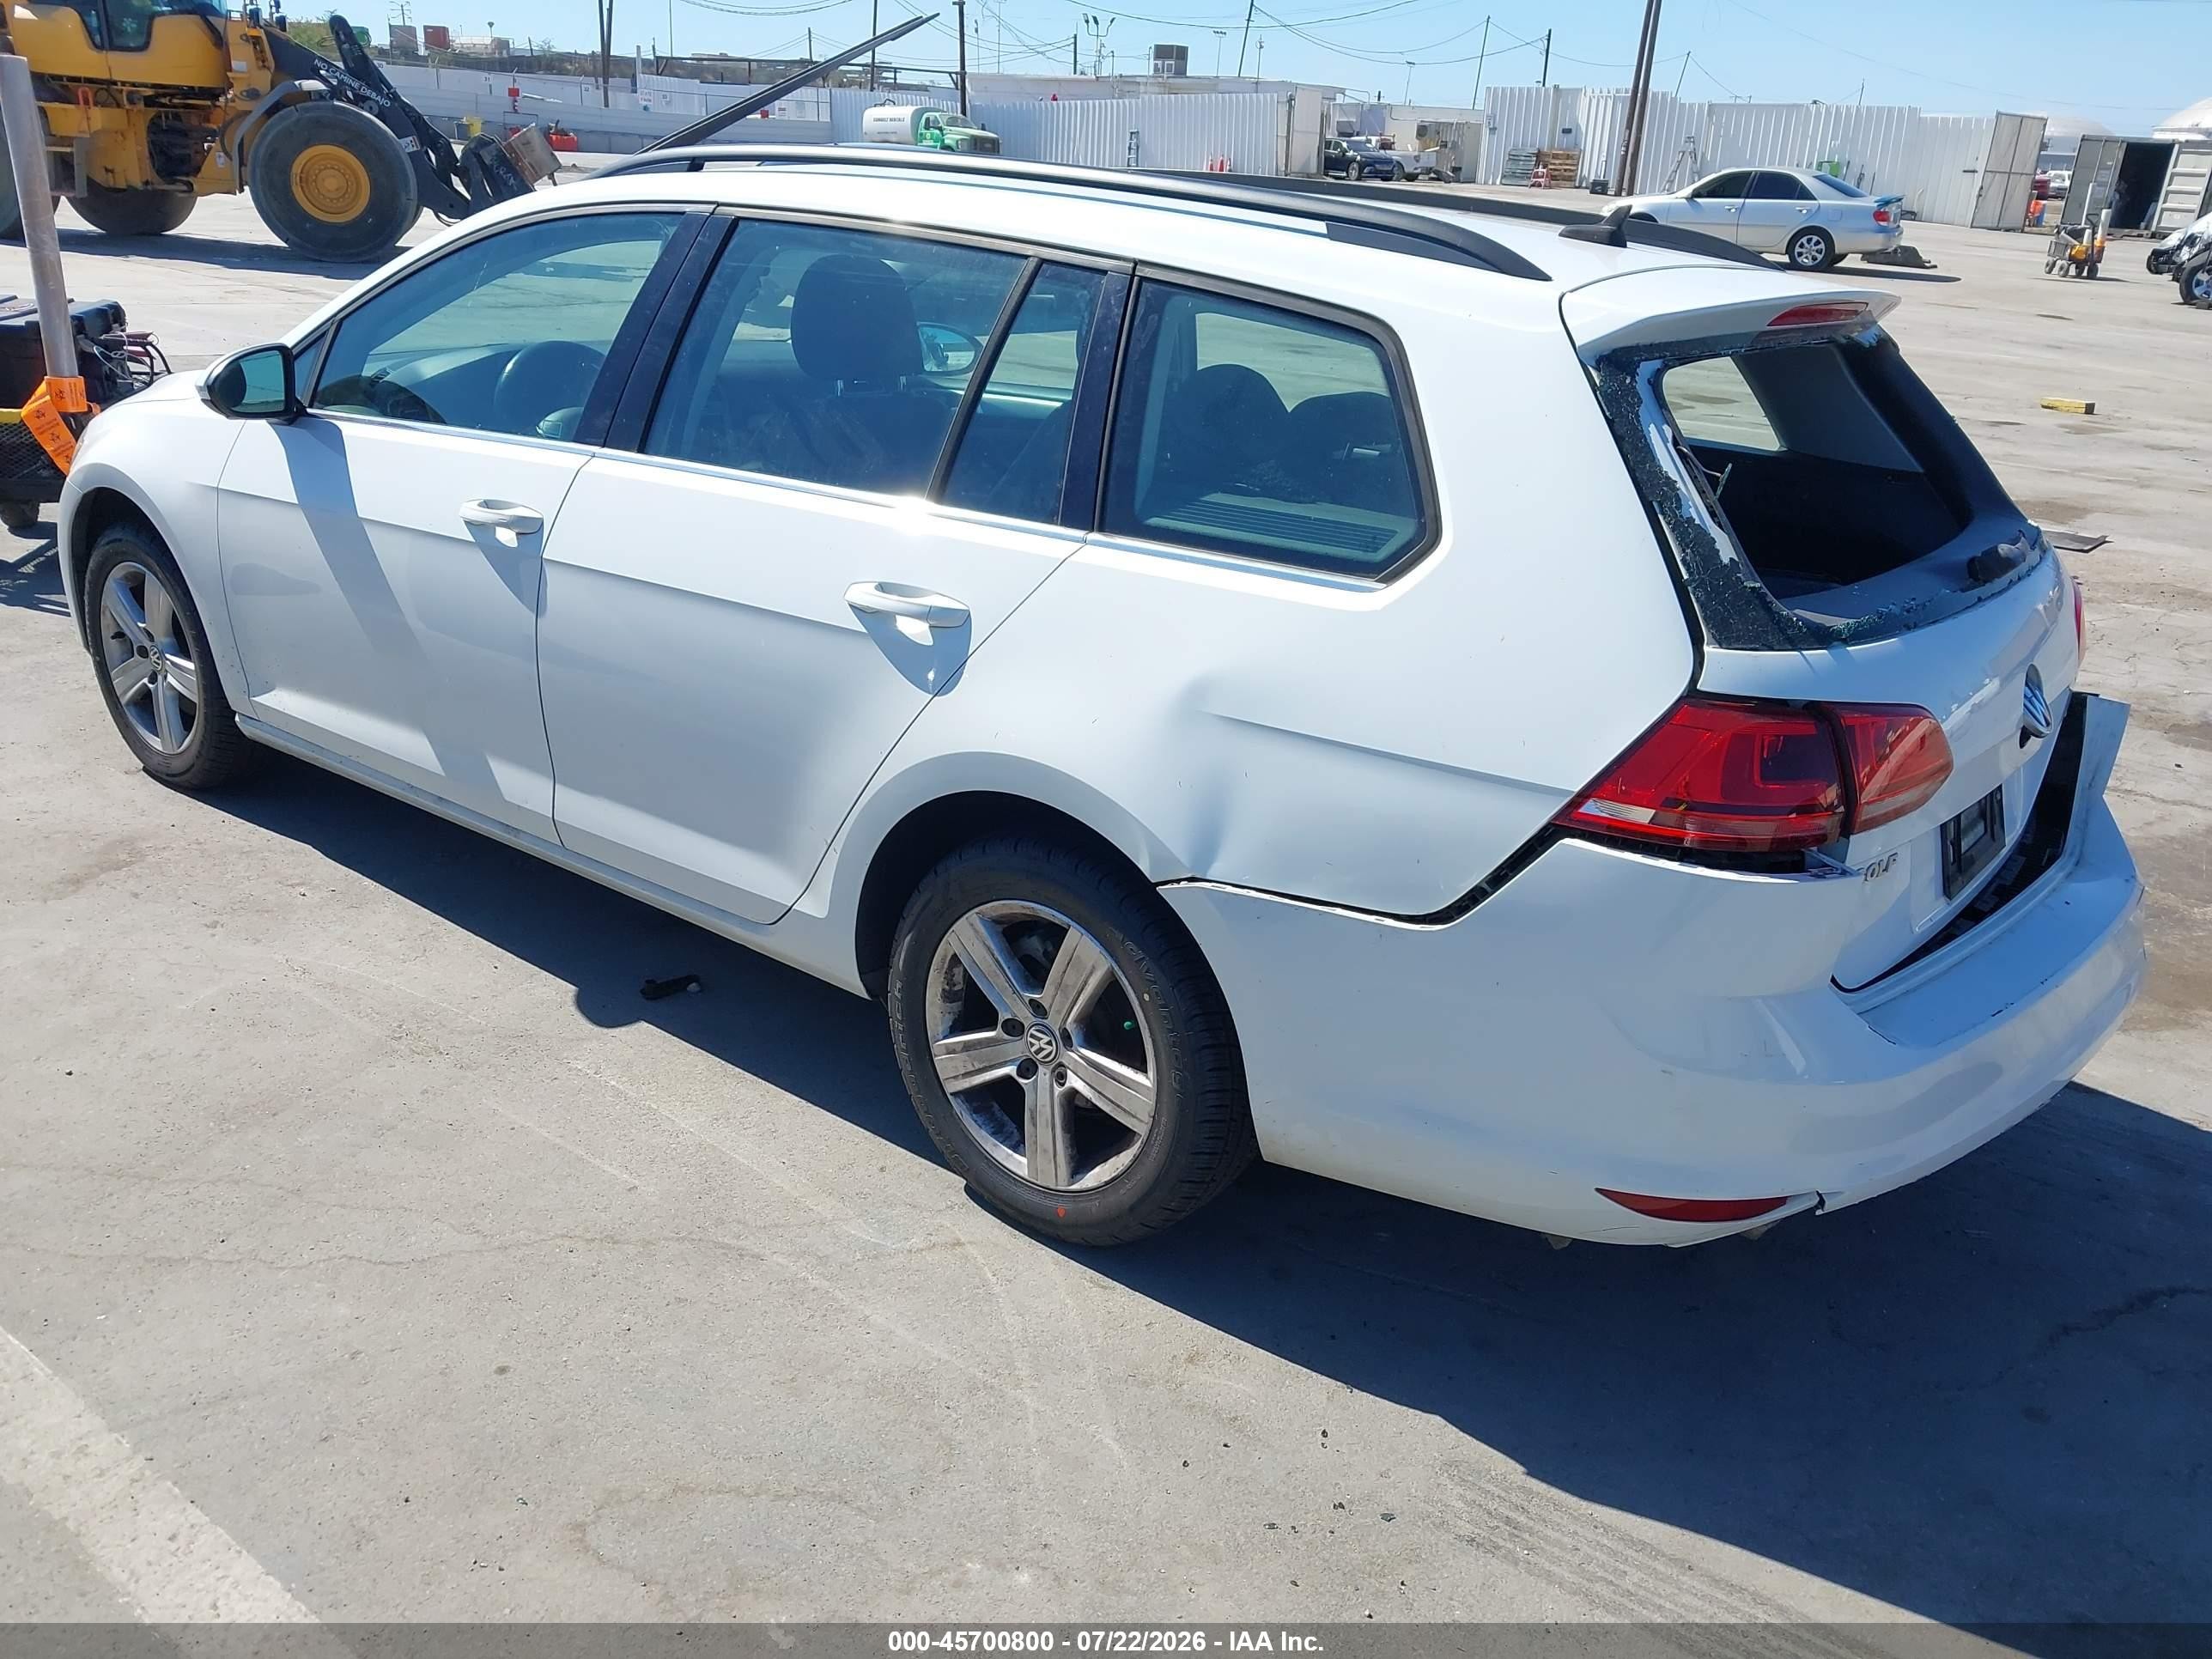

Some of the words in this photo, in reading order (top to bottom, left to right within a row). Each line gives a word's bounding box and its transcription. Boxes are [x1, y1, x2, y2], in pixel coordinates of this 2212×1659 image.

[313, 58, 328, 70] NO
[329, 69, 360, 90] CAMINE
[360, 86, 391, 107] DEBAJO
[1027, 1024, 1057, 1062] VW
